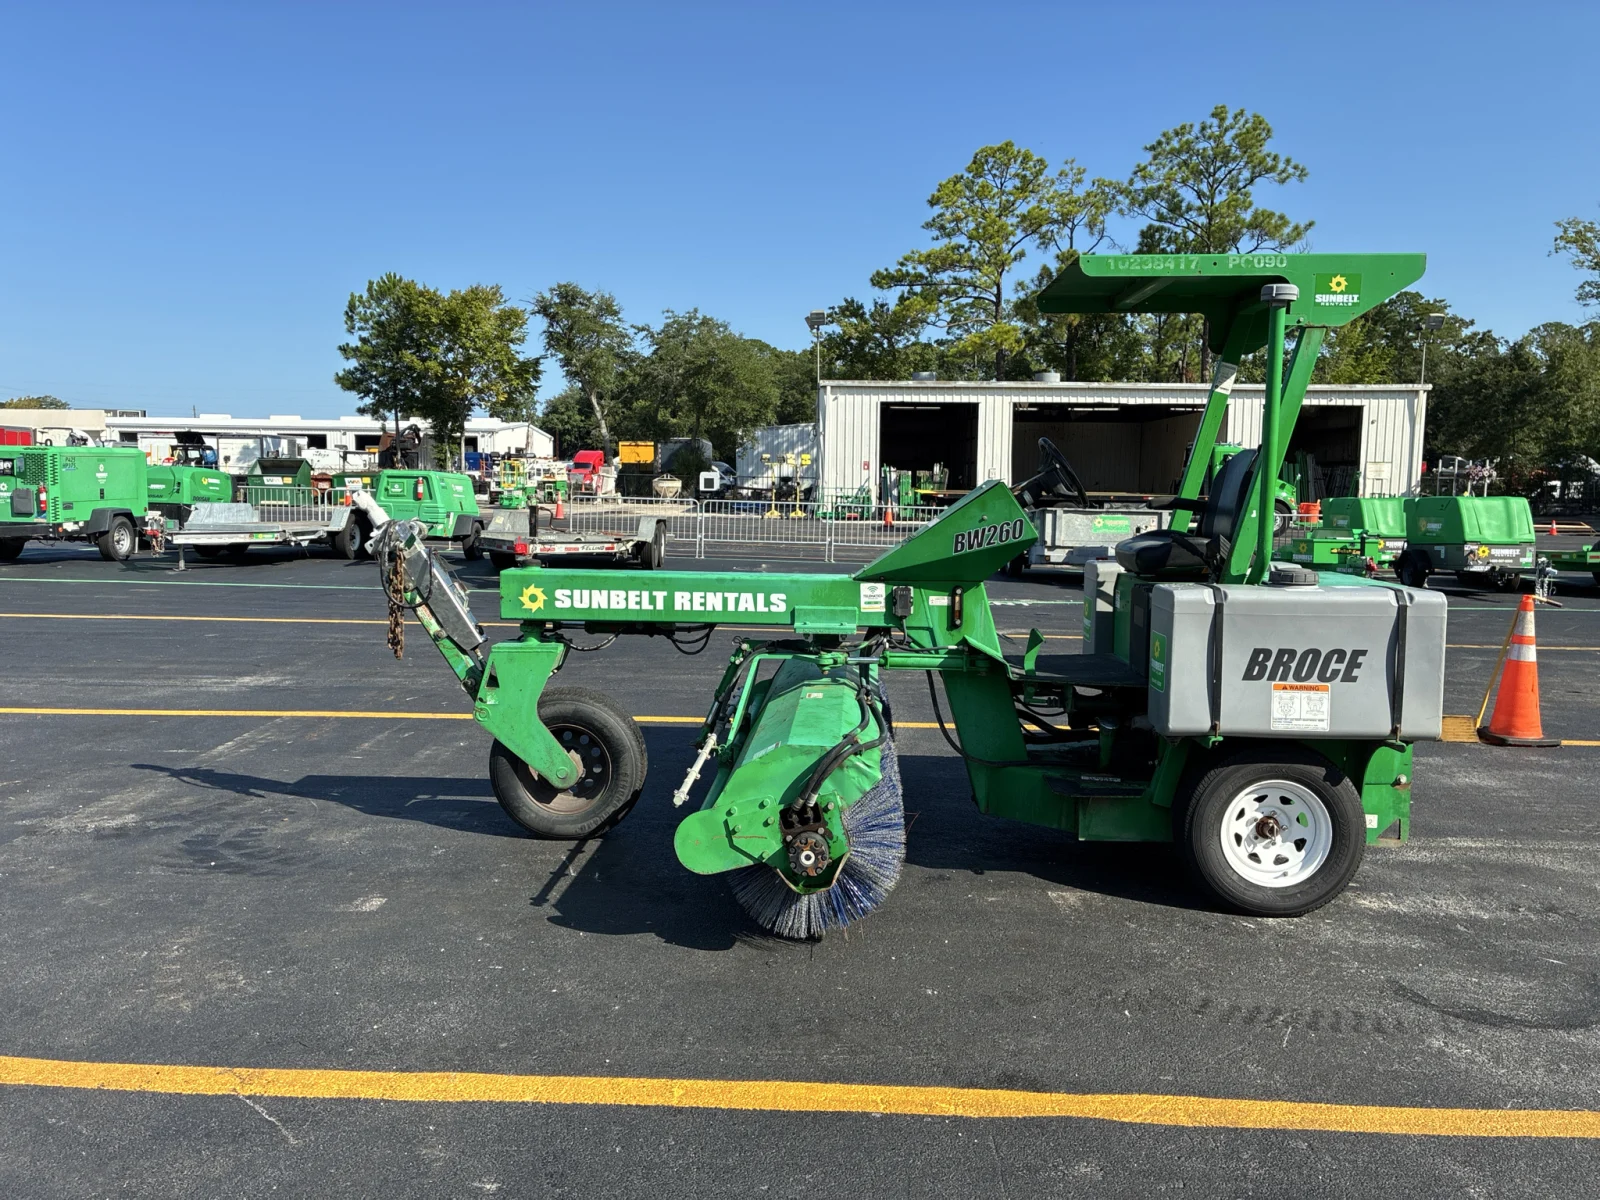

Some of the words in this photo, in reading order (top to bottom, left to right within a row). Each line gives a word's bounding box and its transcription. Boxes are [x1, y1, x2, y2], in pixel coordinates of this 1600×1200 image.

[1228, 255, 1287, 269] PC090
[1315, 294, 1360, 302] SUNBELT
[952, 517, 1025, 556] BW260
[554, 588, 668, 611] SUNBELT
[674, 591, 788, 613] RENTALS
[1241, 647, 1369, 683] BROCE
